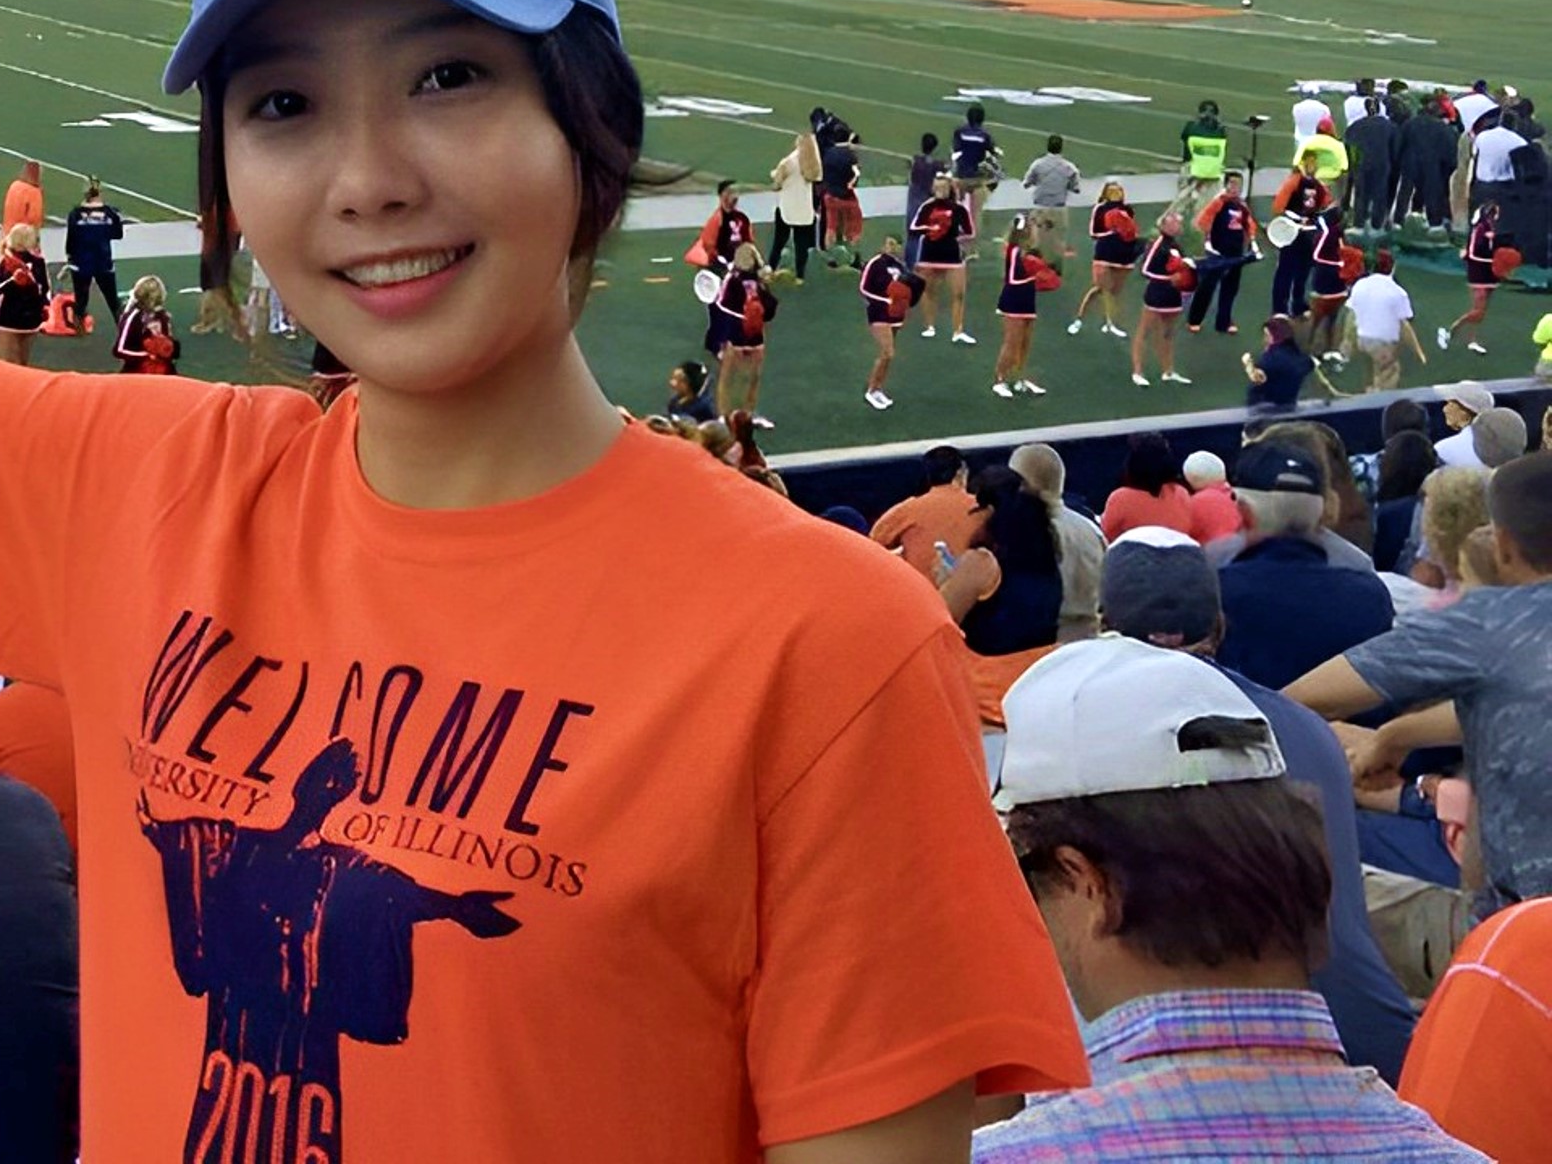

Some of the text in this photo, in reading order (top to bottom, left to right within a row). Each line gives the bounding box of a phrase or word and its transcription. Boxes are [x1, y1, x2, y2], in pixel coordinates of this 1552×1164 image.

[138, 610, 596, 836] WELCOME
[127, 738, 588, 899] ERSITY OF ILLINOIS
[194, 1048, 336, 1164] 2016
